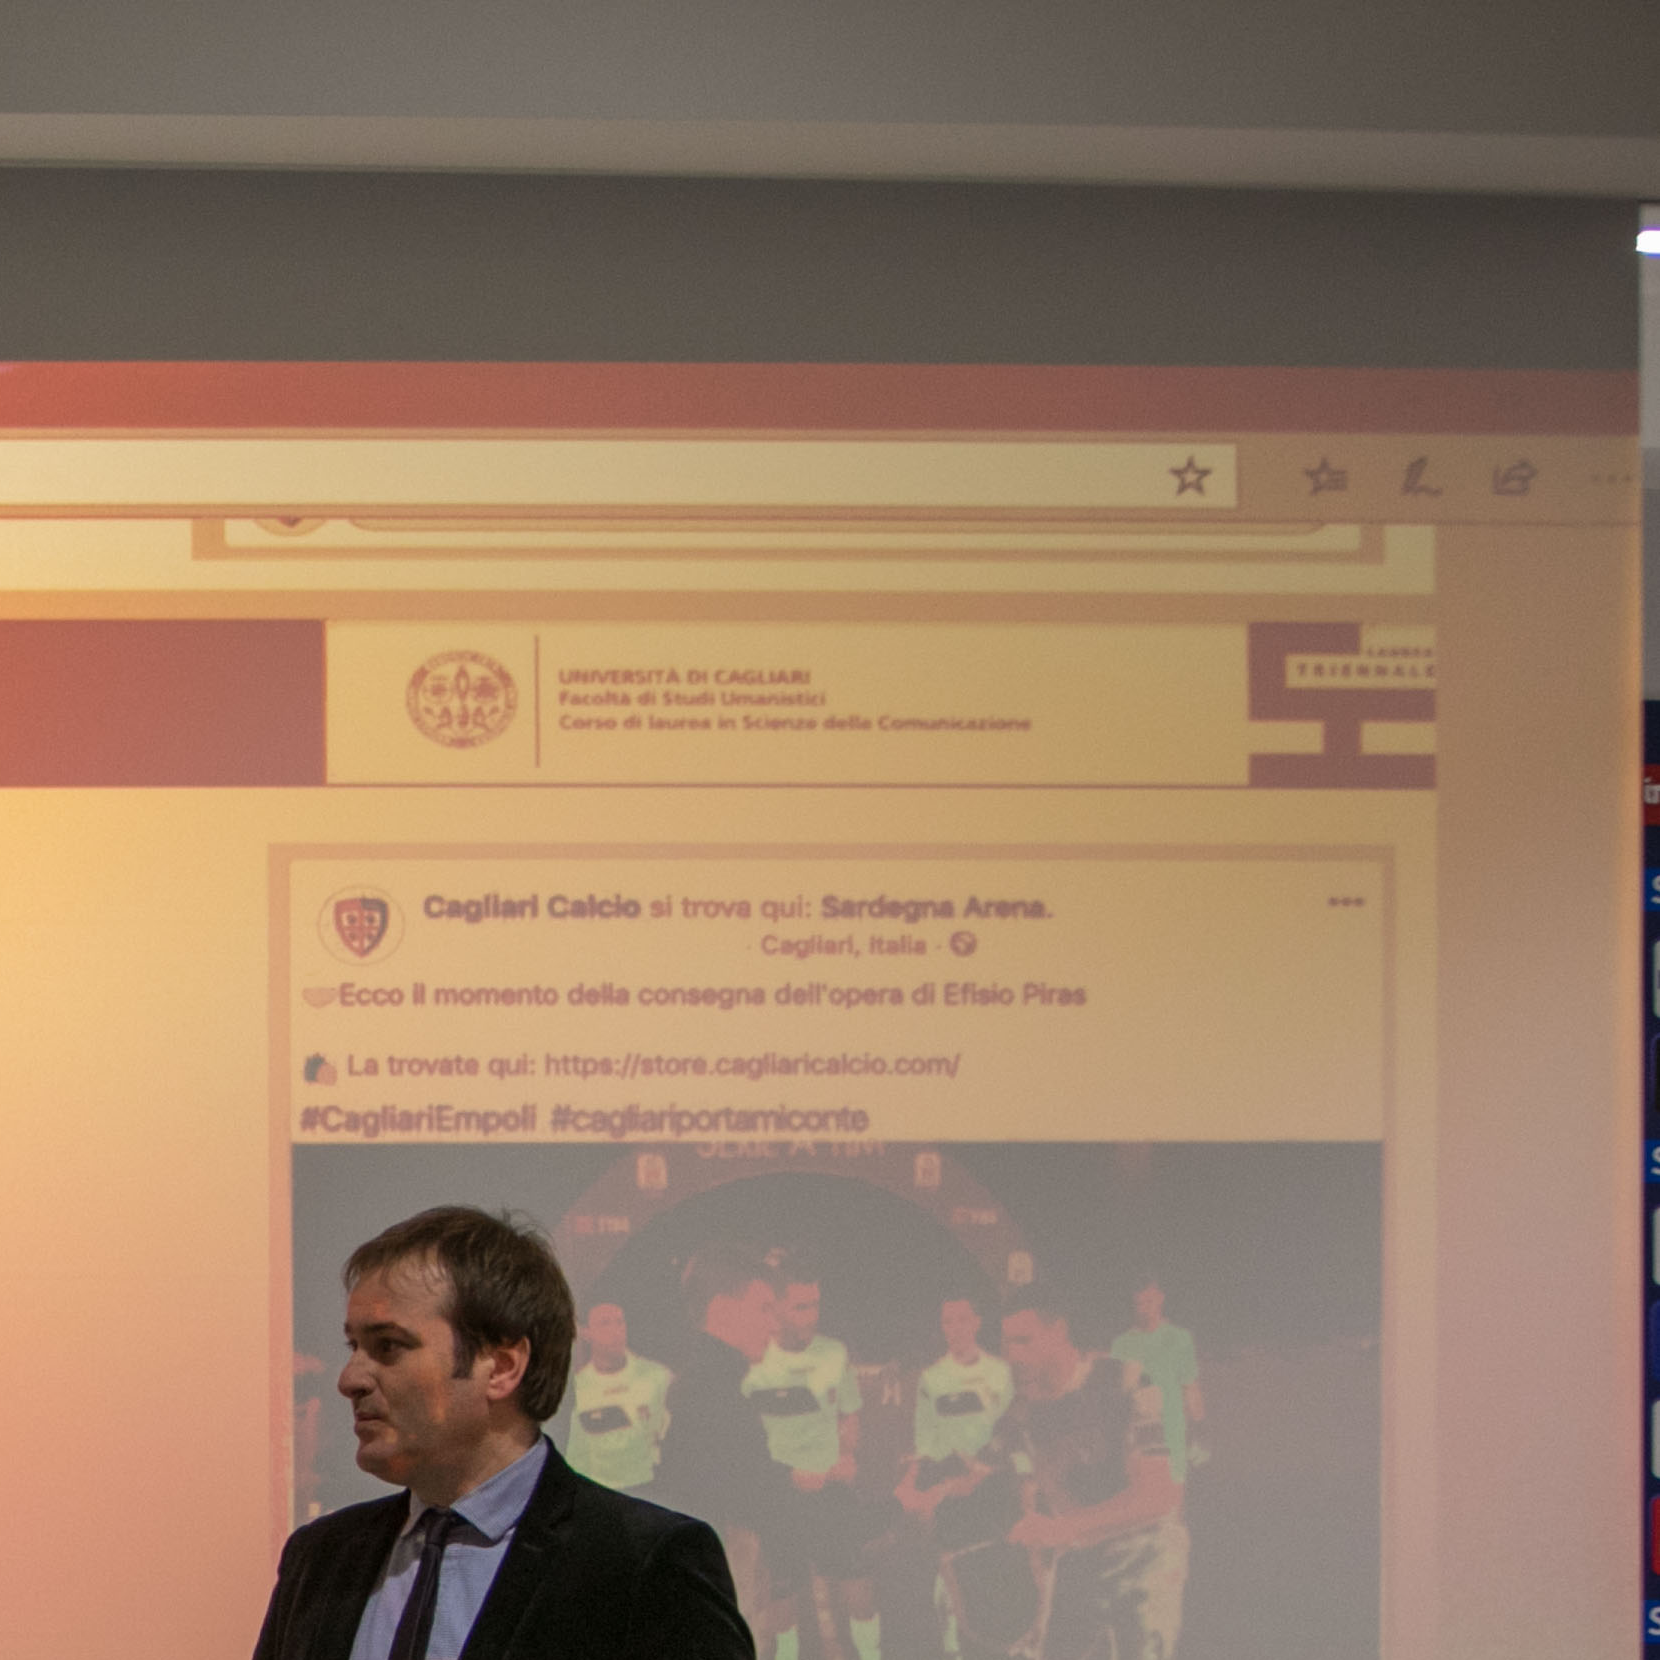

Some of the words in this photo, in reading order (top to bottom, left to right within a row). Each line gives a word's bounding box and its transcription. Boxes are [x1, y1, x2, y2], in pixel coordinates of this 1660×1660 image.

[687, 668, 709, 685] DI
[715, 668, 811, 685] CAGLIARI
[636, 690, 657, 706] di
[663, 690, 715, 706] Studi
[721, 690, 826, 706] Umanistici
[559, 714, 618, 731] Corso
[623, 714, 642, 730] di
[648, 715, 711, 731] laurea
[717, 715, 736, 731] in
[743, 715, 818, 731] Scienze
[878, 715, 1030, 731] Comunicazione
[423, 893, 539, 924] Cagliari
[547, 893, 641, 919] Calcio
[649, 895, 673, 919] si
[682, 897, 752, 919] trova
[760, 895, 812, 923] qui:
[821, 894, 955, 924] Sardegna
[963, 895, 1055, 919] Arena.
[760, 933, 861, 959] Cagliari,
[869, 934, 927, 955] Italia
[338, 982, 405, 1007] Ecco
[412, 982, 426, 1006] il
[434, 984, 559, 1007] momento
[567, 982, 631, 1007] della
[638, 986, 766, 1011] consegna
[774, 982, 904, 1011] dell'opera
[911, 982, 936, 1007] di
[943, 982, 1014, 1007] Efisio
[1022, 982, 1088, 1007] Piras
[347, 1053, 379, 1077] La
[387, 1054, 479, 1077] trovate
[487, 1053, 536, 1080] qui:
[544, 1052, 962, 1082] https://store.cagliaricalcio.com/
[300, 1103, 538, 1139] #CagliariEmpoli
[549, 1103, 870, 1139] #cagliariportamiconte
